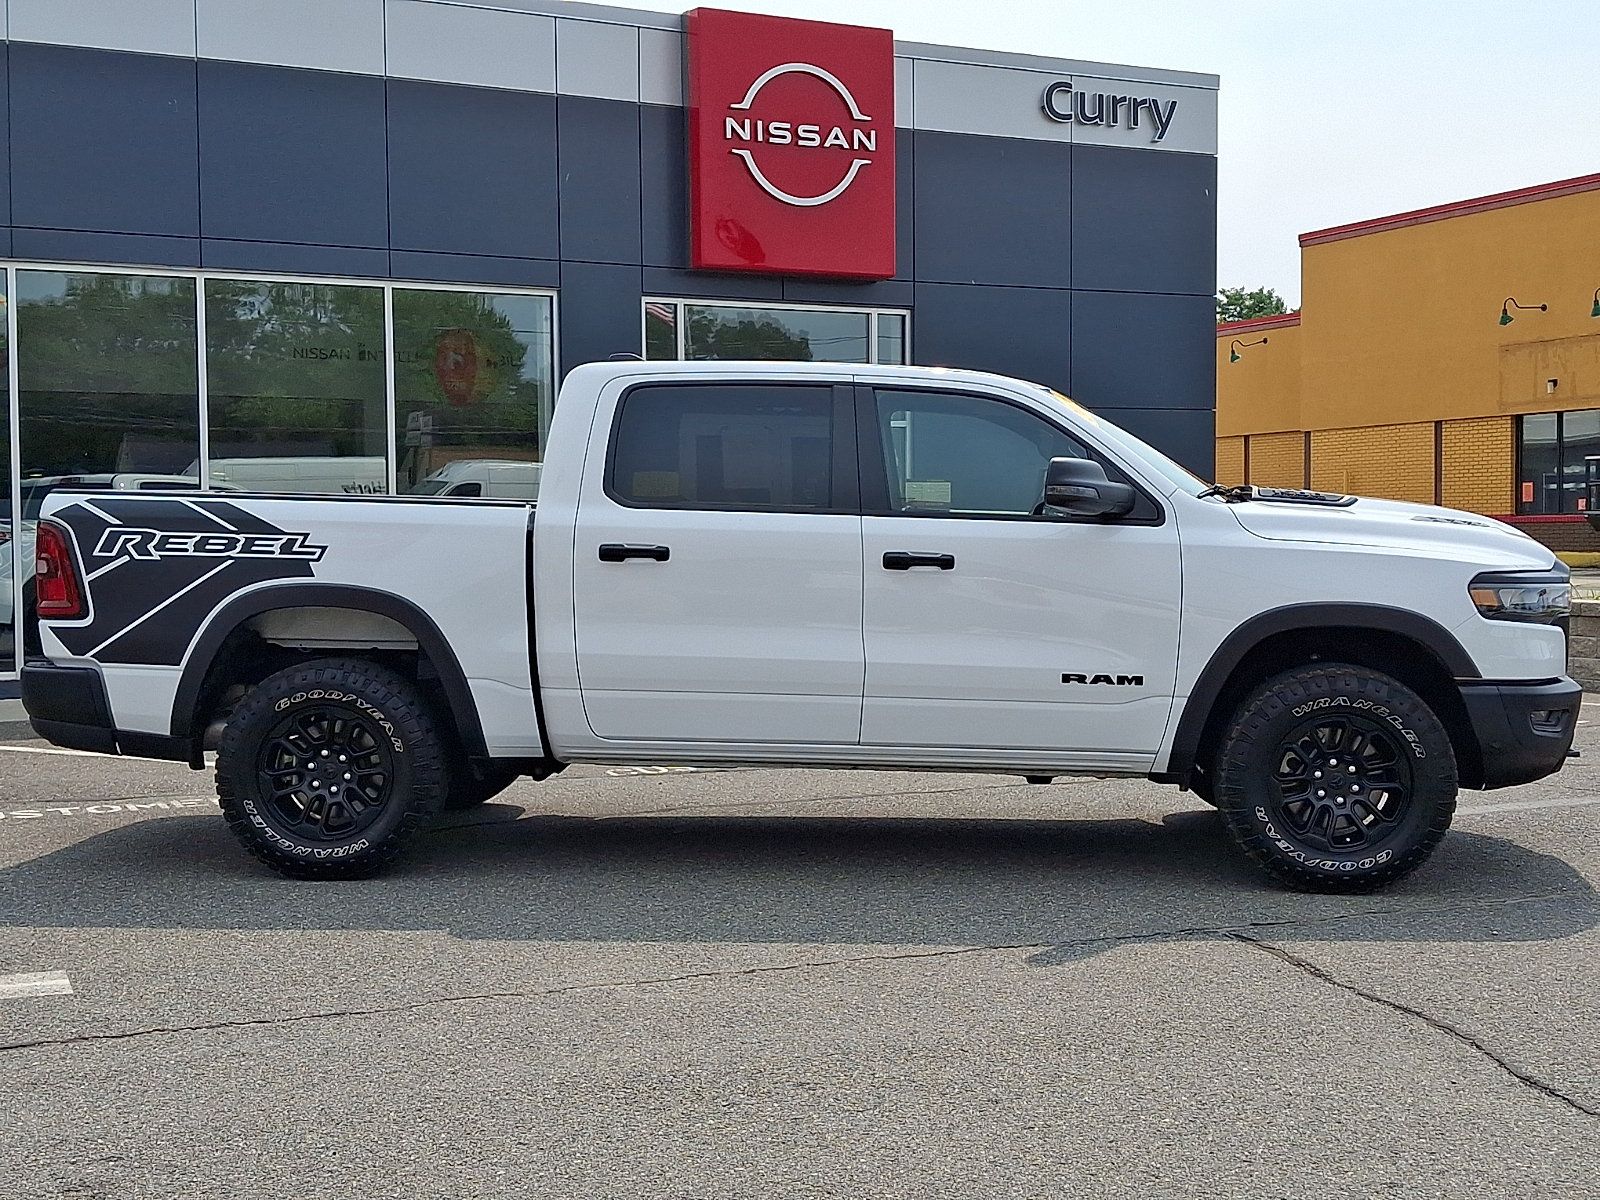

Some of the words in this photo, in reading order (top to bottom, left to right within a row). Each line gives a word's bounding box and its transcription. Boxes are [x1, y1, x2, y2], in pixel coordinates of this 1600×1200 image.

[724, 116, 877, 151] NISSAN
[1042, 80, 1178, 141] Curry
[292, 346, 351, 360] NISSAN
[92, 527, 330, 563] REBEL
[1061, 672, 1144, 686] RAM
[274, 689, 404, 753] GOODYEAR
[1291, 696, 1427, 759] WRANGLER
[0, 798, 219, 820] STOME
[243, 799, 370, 859] WRANGLER
[1255, 805, 1393, 871] GOODYEAR
